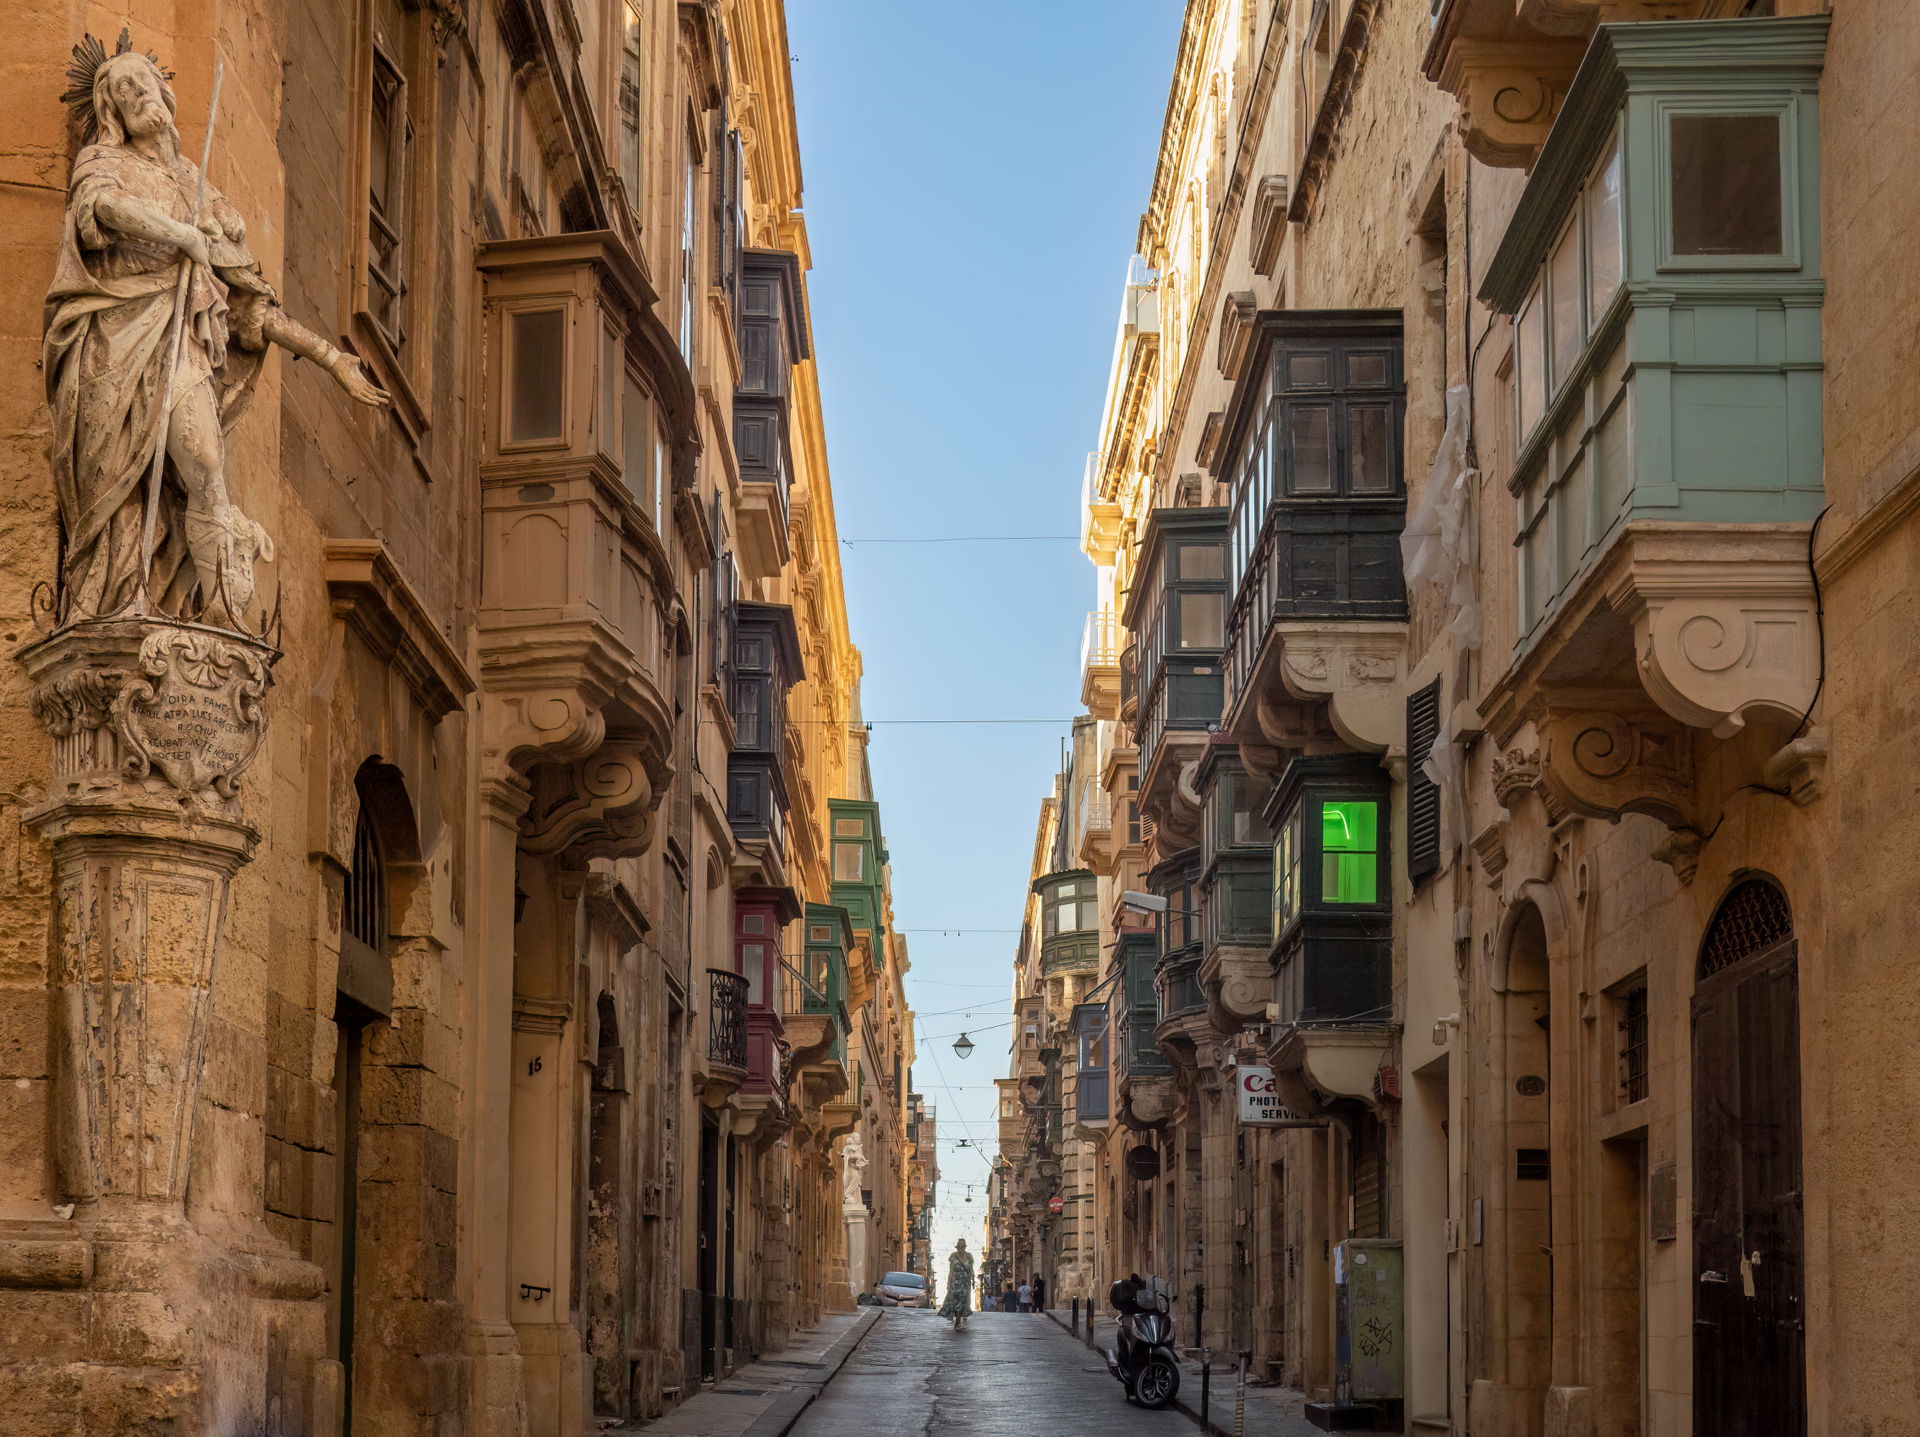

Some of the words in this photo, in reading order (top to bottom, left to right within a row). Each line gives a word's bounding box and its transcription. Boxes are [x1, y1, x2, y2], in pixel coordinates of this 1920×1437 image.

[168, 694, 196, 705] DIRA
[204, 696, 231, 716] FAMES
[528, 1055, 543, 1077] 15
[1243, 1074, 1277, 1093] Ca
[1261, 1109, 1306, 1119] SERVI
